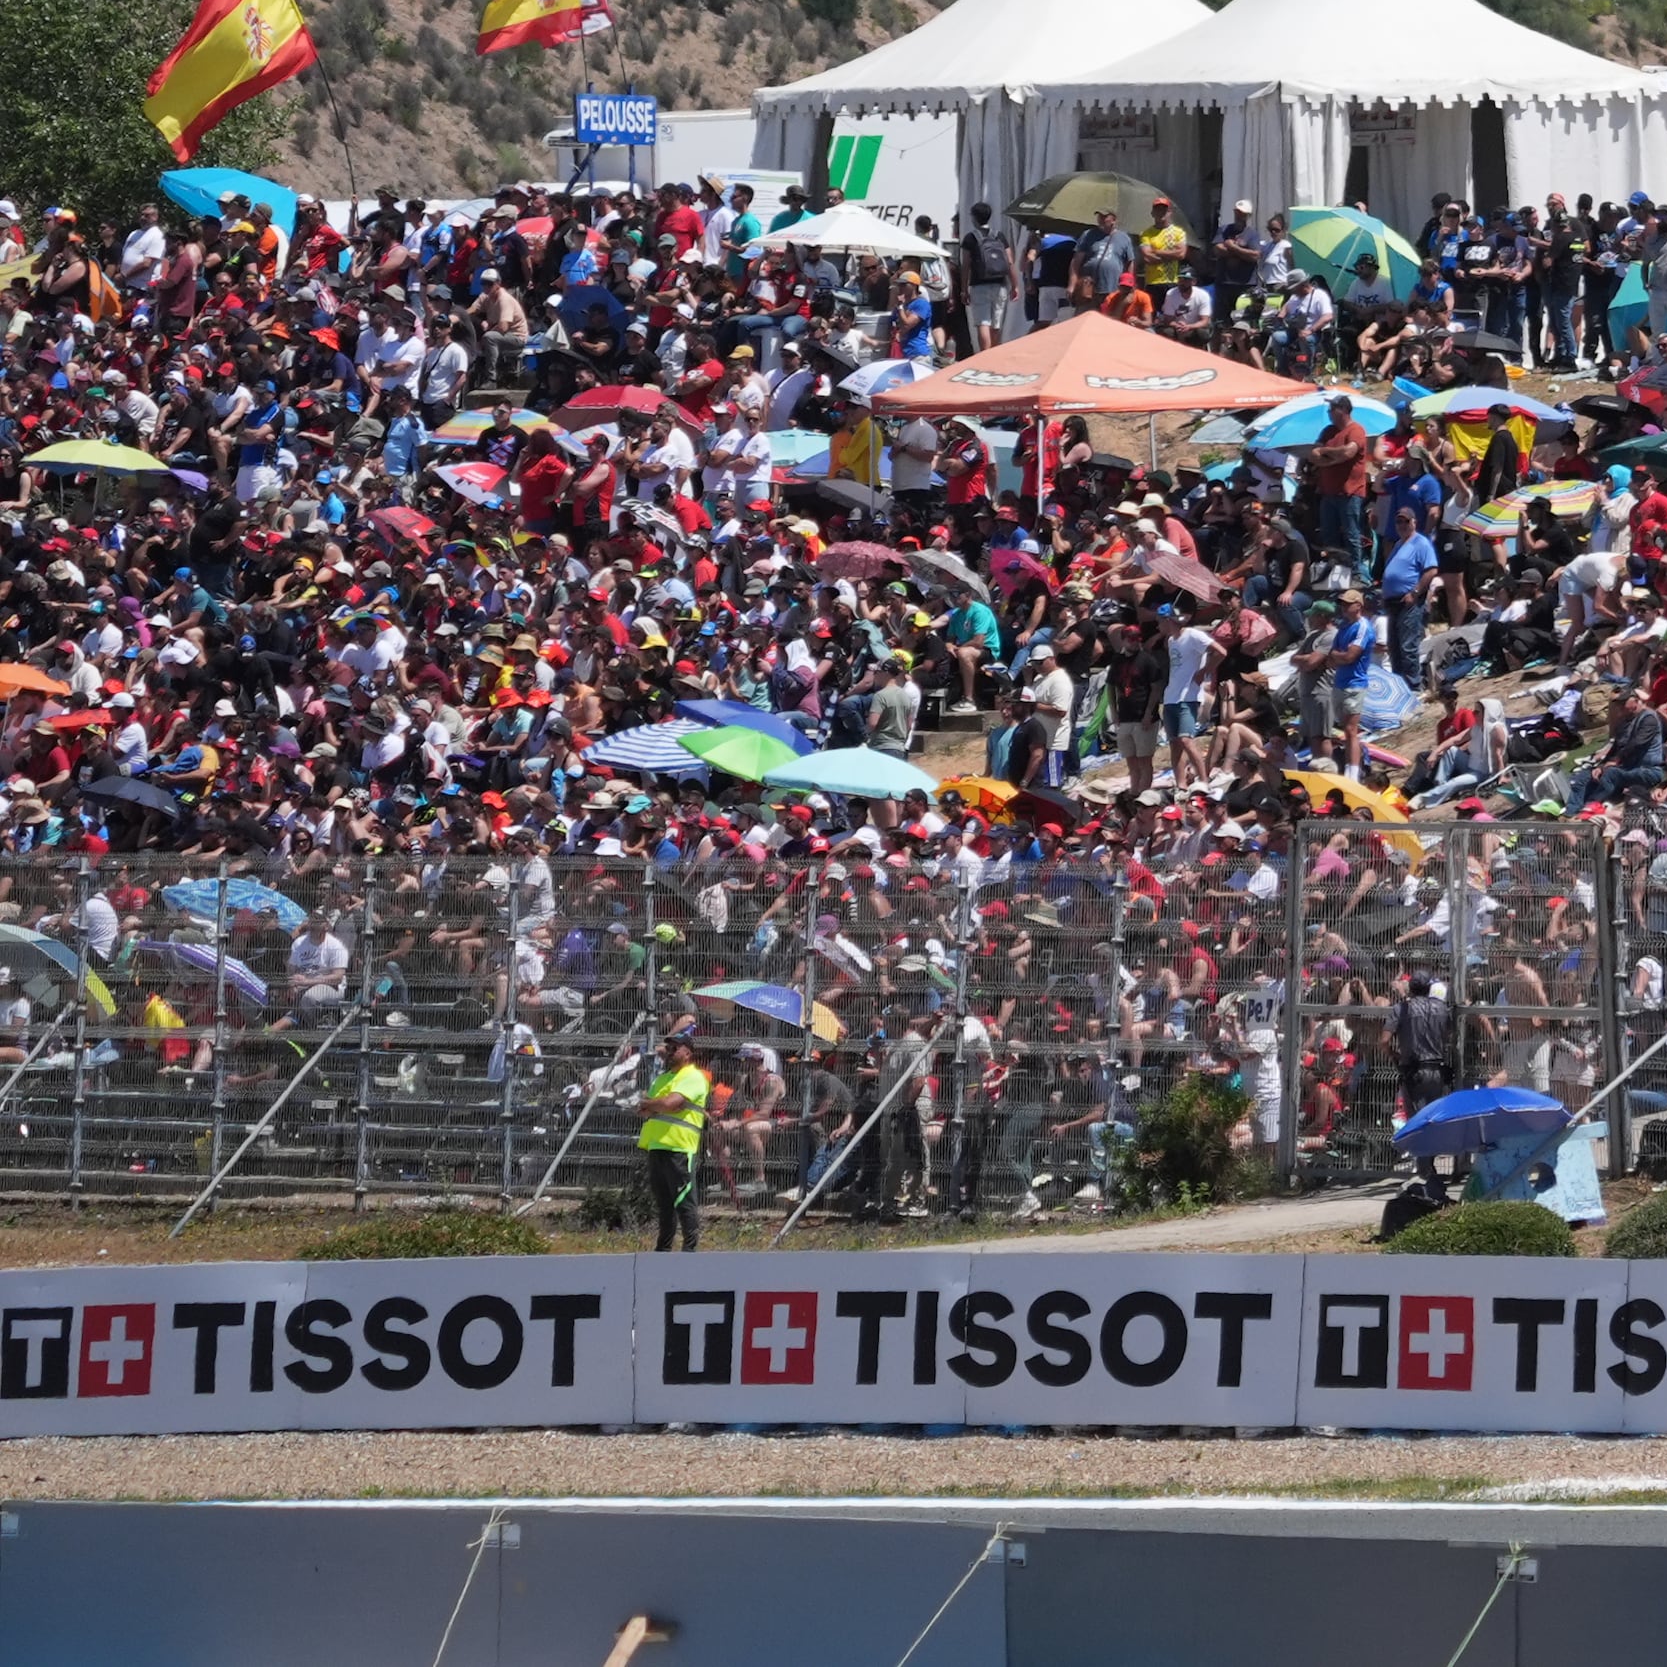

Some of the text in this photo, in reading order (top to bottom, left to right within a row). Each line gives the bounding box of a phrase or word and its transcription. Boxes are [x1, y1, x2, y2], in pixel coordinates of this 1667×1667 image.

[580, 99, 654, 133] PELOUSSE
[172, 1293, 602, 1395] TISSOT
[835, 1289, 1273, 1389] TISSOT
